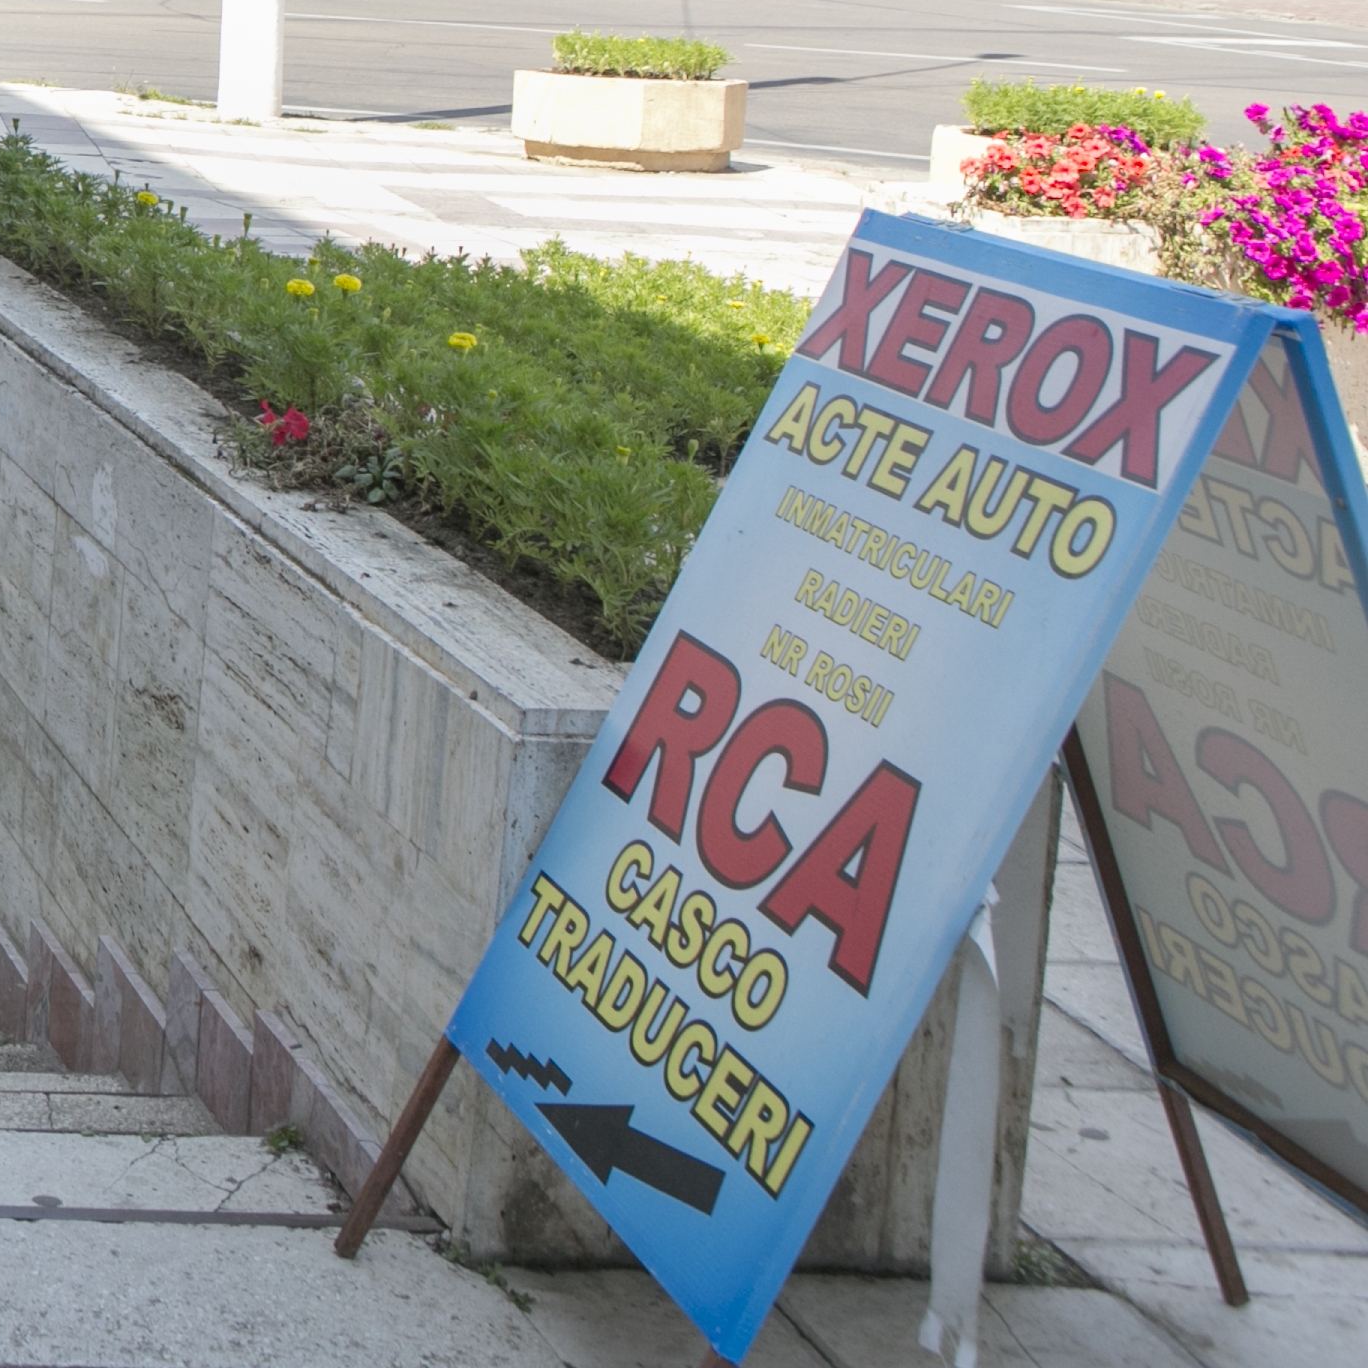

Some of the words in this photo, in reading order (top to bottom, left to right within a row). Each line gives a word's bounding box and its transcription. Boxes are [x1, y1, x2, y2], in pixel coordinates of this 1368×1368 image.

[795, 247, 1222, 490] XEROX
[764, 381, 934, 502] ACTE
[914, 443, 1117, 581] AUTO
[775, 485, 1015, 629] INMATRICULARI
[760, 623, 808, 678] NR
[804, 650, 895, 729] ROSII
[794, 568, 921, 662] RADIERI
[601, 628, 922, 999] RCA
[605, 839, 789, 1032] CASCO
[516, 870, 816, 1201] TRADUCERI
